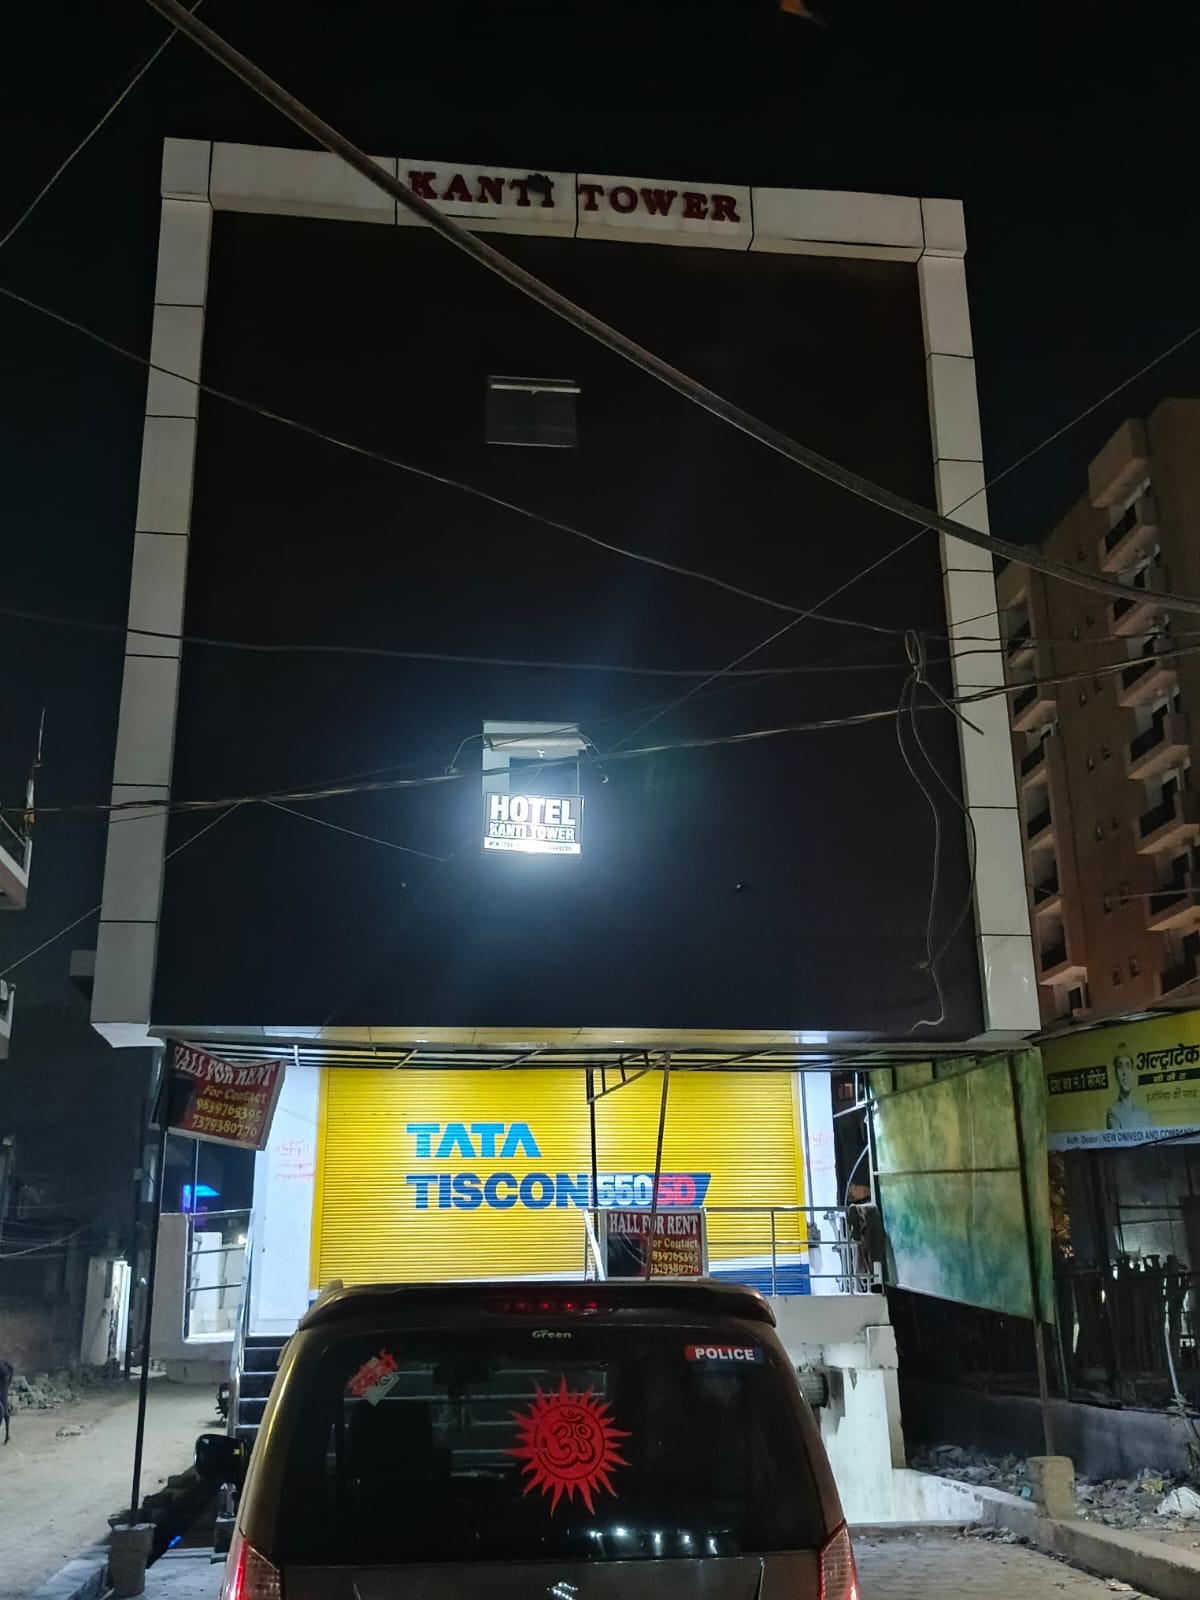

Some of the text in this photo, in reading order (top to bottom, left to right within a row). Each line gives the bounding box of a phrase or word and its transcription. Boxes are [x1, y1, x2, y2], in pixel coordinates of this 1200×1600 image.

[408, 170, 740, 222] KANTI TOWER
[490, 794, 576, 825] HOTEL
[489, 822, 575, 841] KANTI TOWER
[205, 1058, 234, 1084] FOR
[235, 1064, 276, 1087] RENT
[203, 1085, 224, 1097] For
[406, 1123, 542, 1158] TATA
[406, 1172, 590, 1209] TISCON
[609, 1213, 640, 1233] HALL
[667, 1215, 698, 1235] RENT
[664, 1238, 698, 1249] Contact
[531, 1329, 572, 1339] Green
[694, 1346, 756, 1362] POLICE
